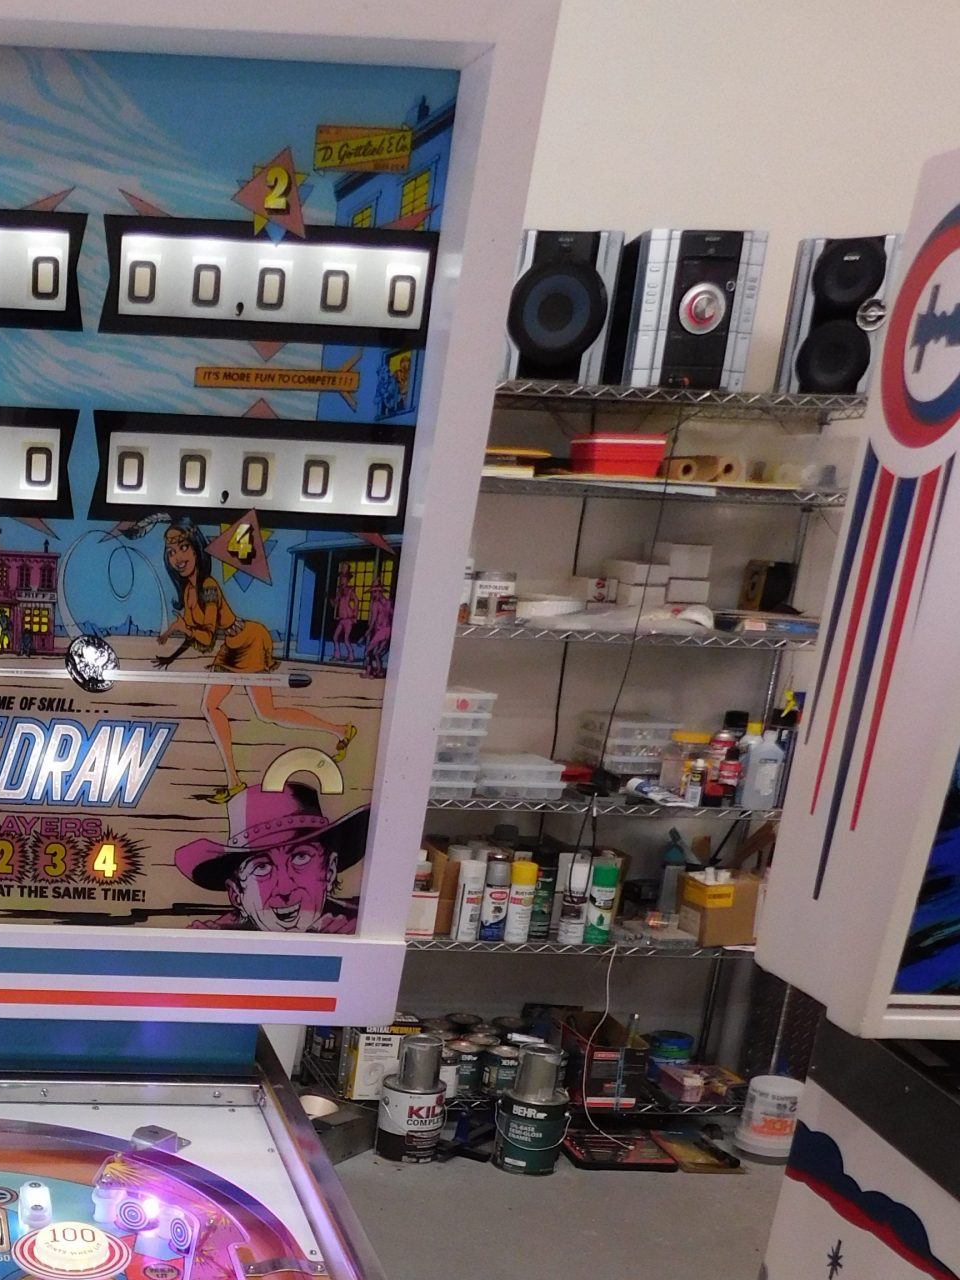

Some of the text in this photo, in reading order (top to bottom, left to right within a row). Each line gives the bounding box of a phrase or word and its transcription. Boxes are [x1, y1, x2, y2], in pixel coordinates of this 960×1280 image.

[263, 166, 291, 215] 2
[203, 370, 219, 381] IT'S
[222, 371, 250, 382] MORE
[254, 372, 276, 383] FUN
[278, 374, 289, 384] TO
[227, 525, 258, 564] 4
[19, 696, 36, 711] OF
[43, 843, 67, 878] 3
[92, 843, 118, 878] 4
[17, 885, 48, 898] THE
[52, 886, 96, 900] SAME
[101, 888, 146, 902] TIME!
[512, 1104, 538, 1119] BEHR
[49, 1227, 96, 1243] 100
